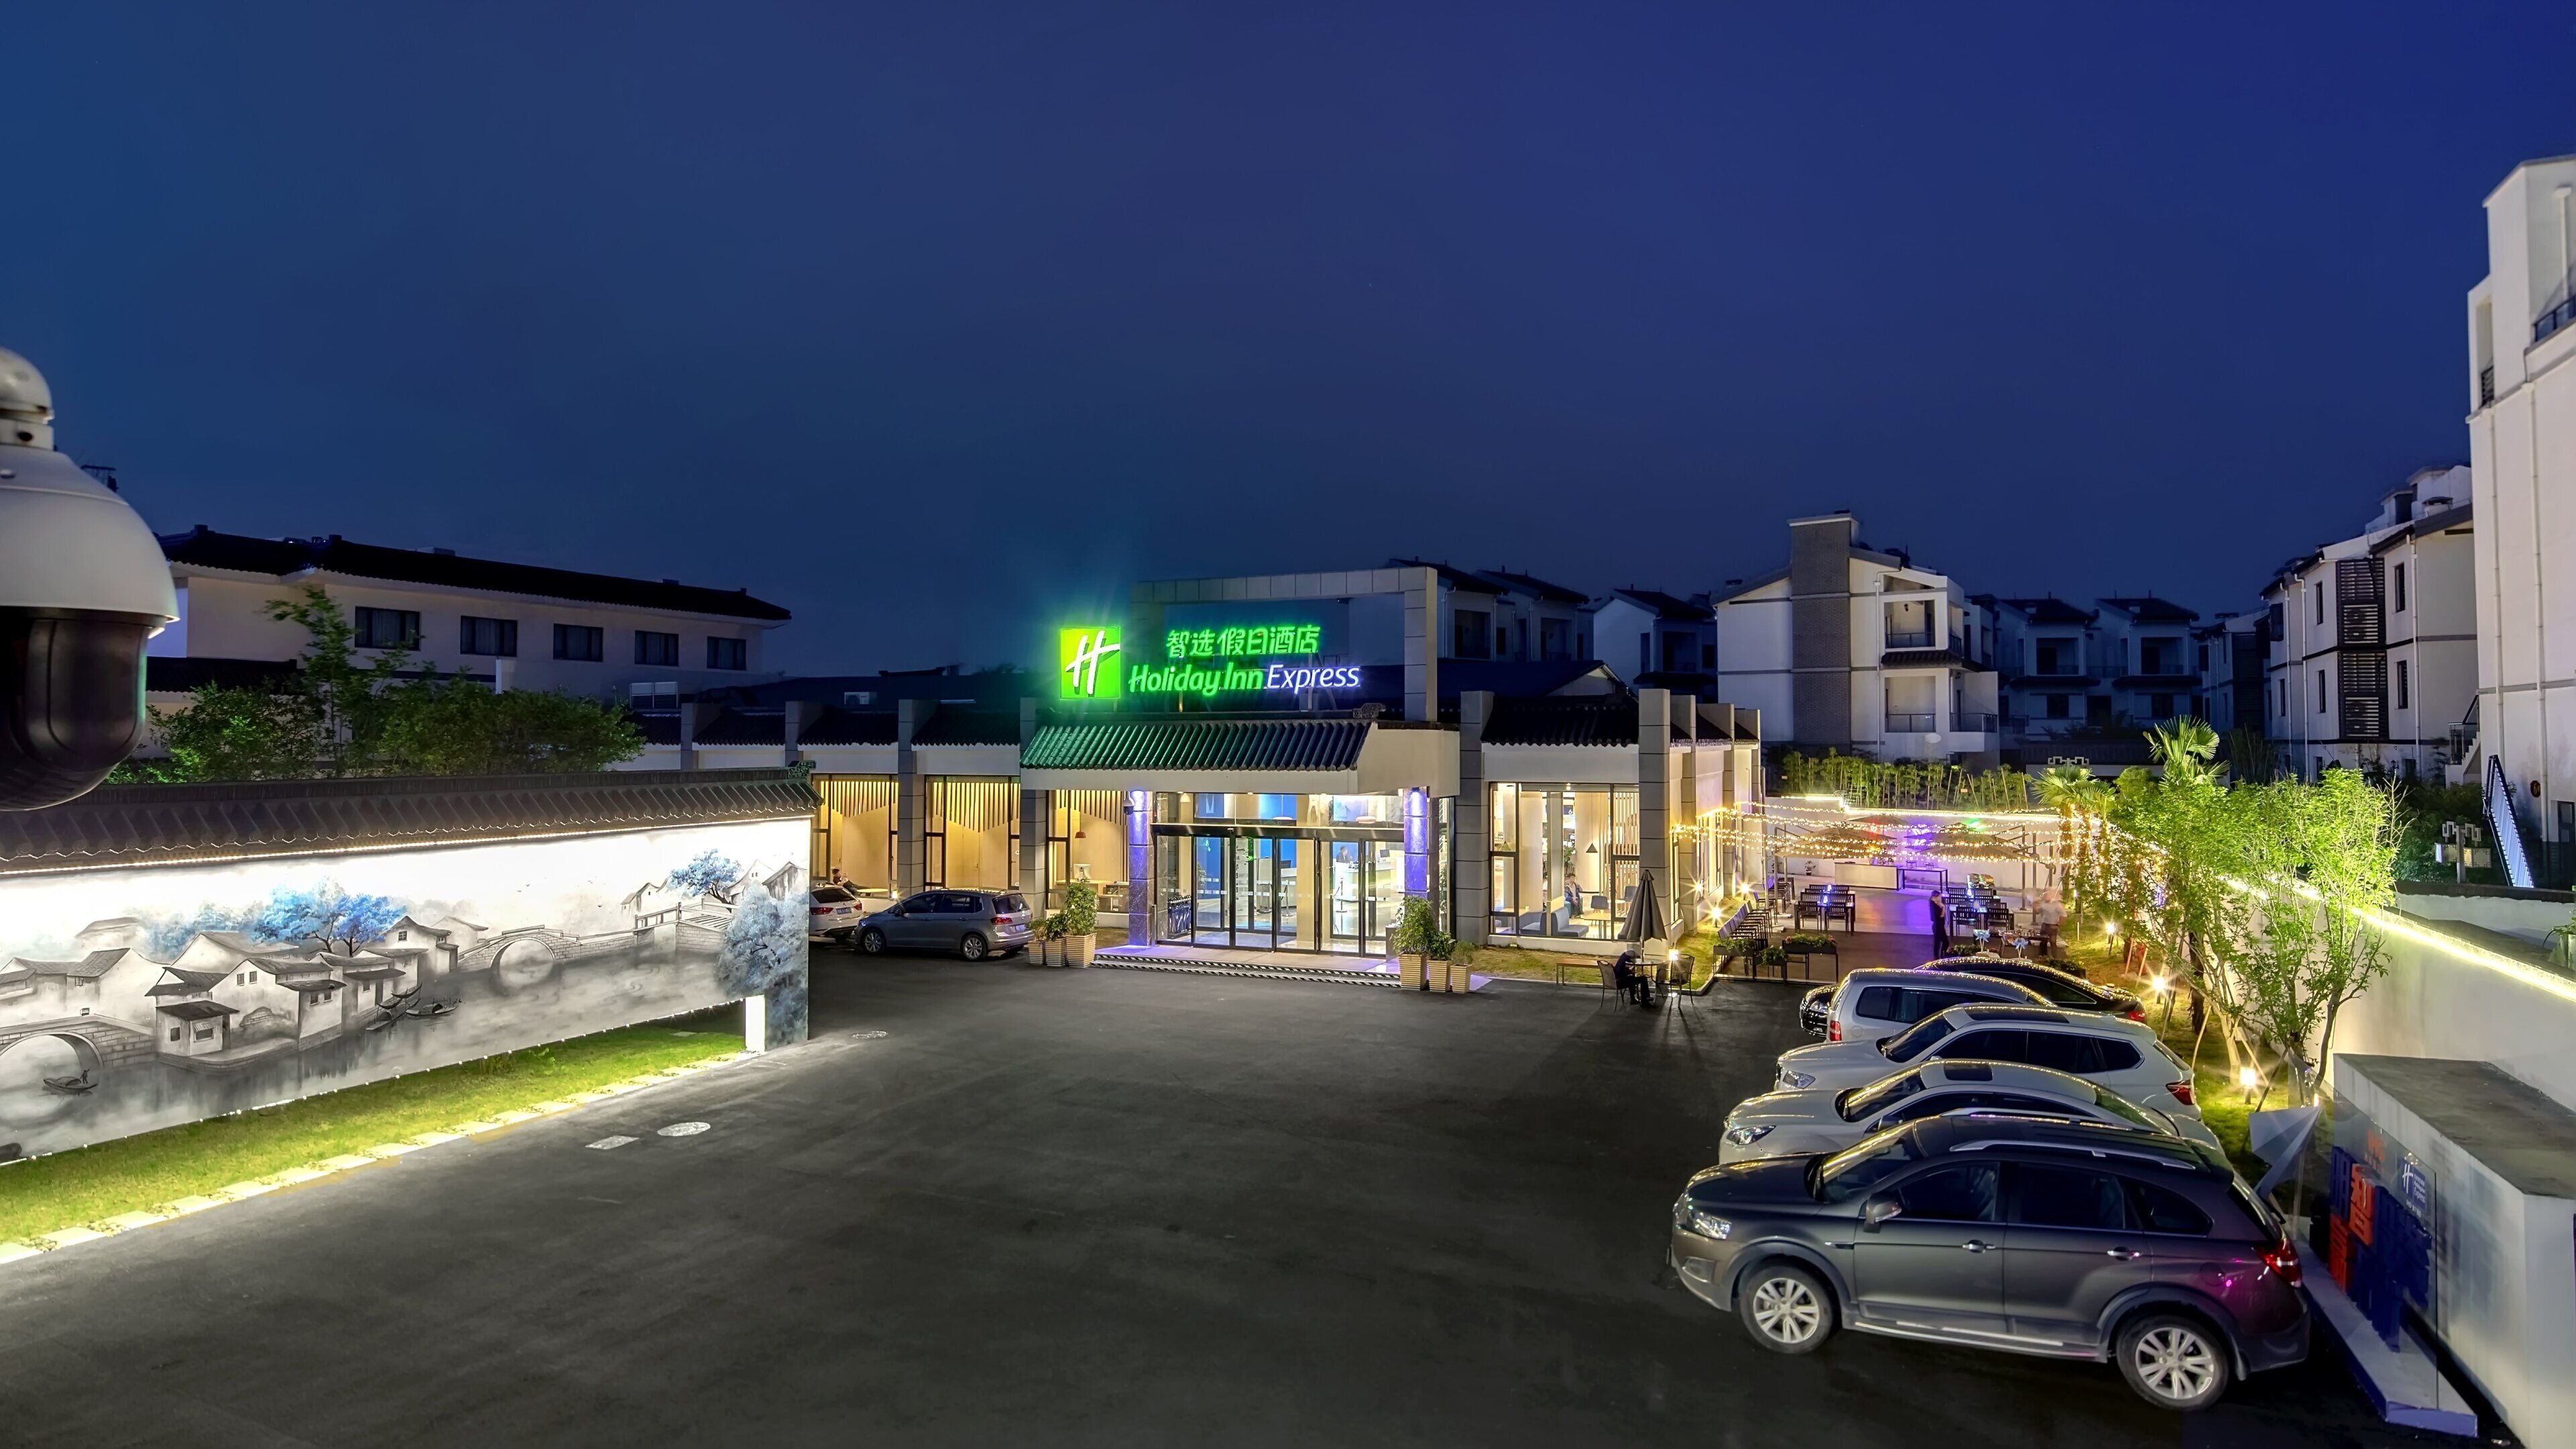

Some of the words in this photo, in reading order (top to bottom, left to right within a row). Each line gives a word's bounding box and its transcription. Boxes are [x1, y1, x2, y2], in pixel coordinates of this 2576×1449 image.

[1166, 625, 1321, 658] 智选假日酒店
[1128, 663, 1221, 696] Holiday
[1223, 661, 1265, 690] Inn
[1267, 663, 1360, 695] Express
